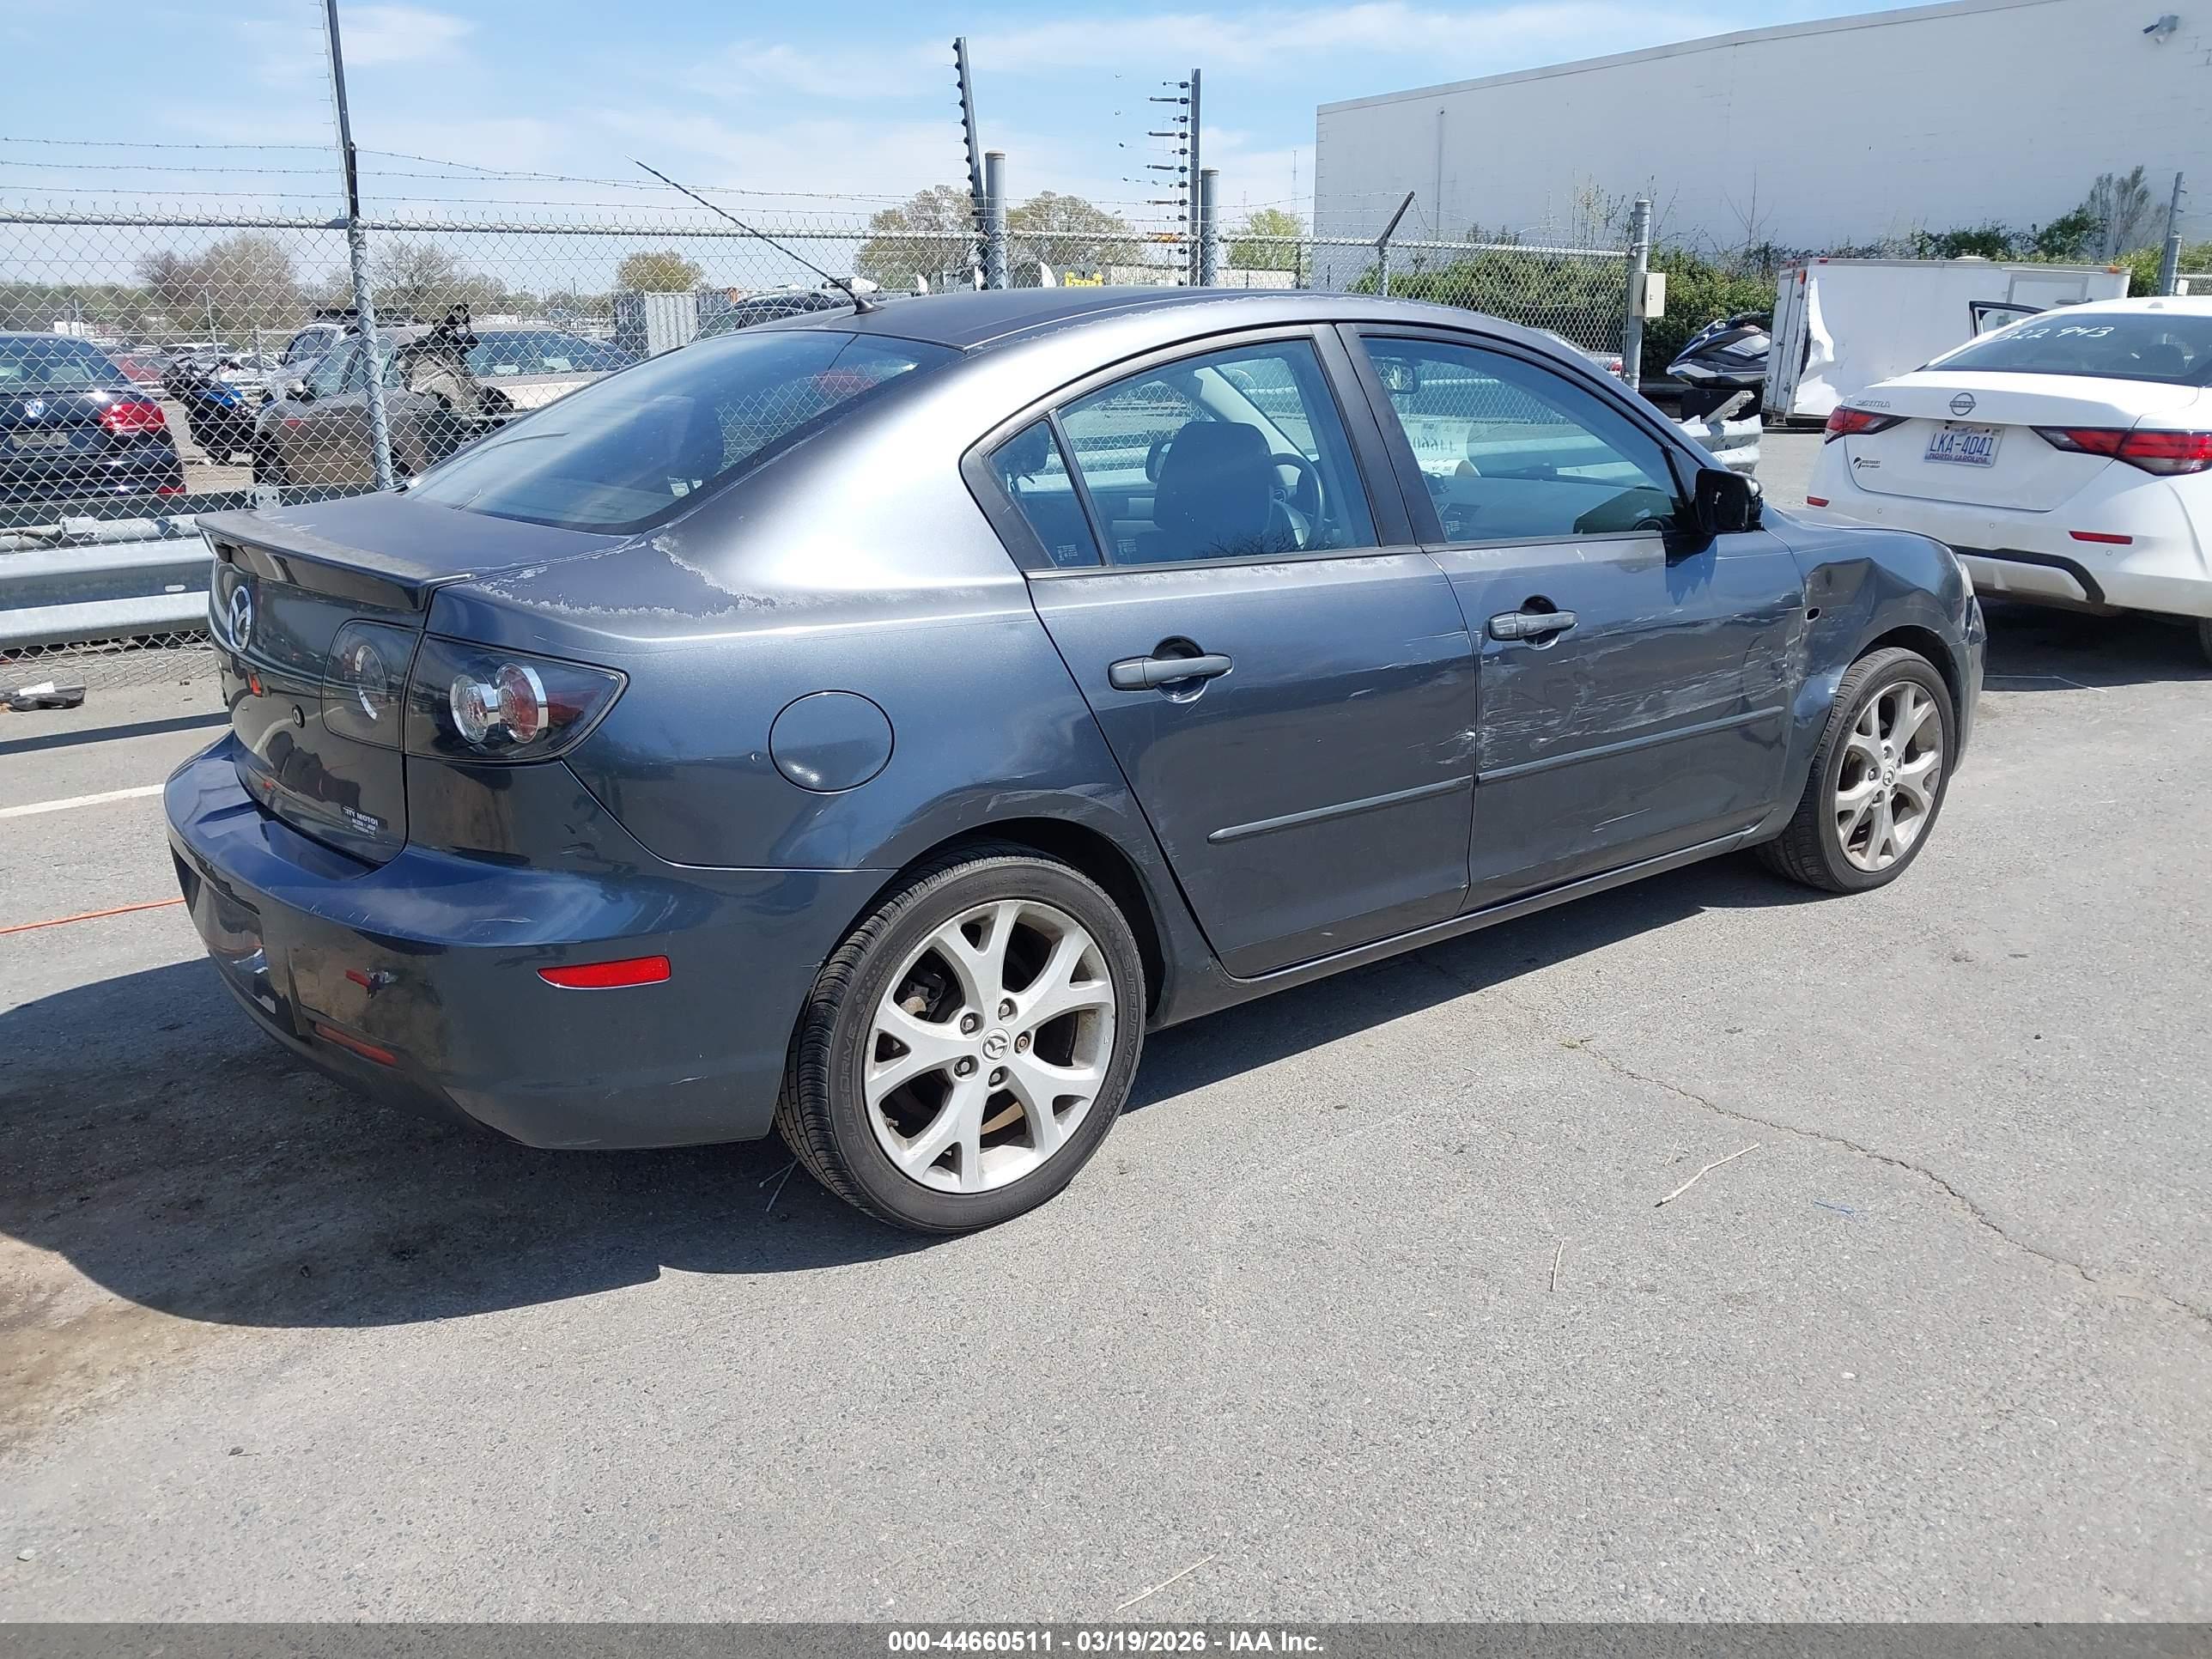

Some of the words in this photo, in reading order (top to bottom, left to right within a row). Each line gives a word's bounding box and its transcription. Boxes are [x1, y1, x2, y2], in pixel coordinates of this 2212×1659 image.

[2056, 325, 2116, 337] 943
[1929, 433, 1994, 456] LKA-4041
[1929, 453, 1953, 461] NORTH
[1954, 454, 1988, 463] CAROLINA
